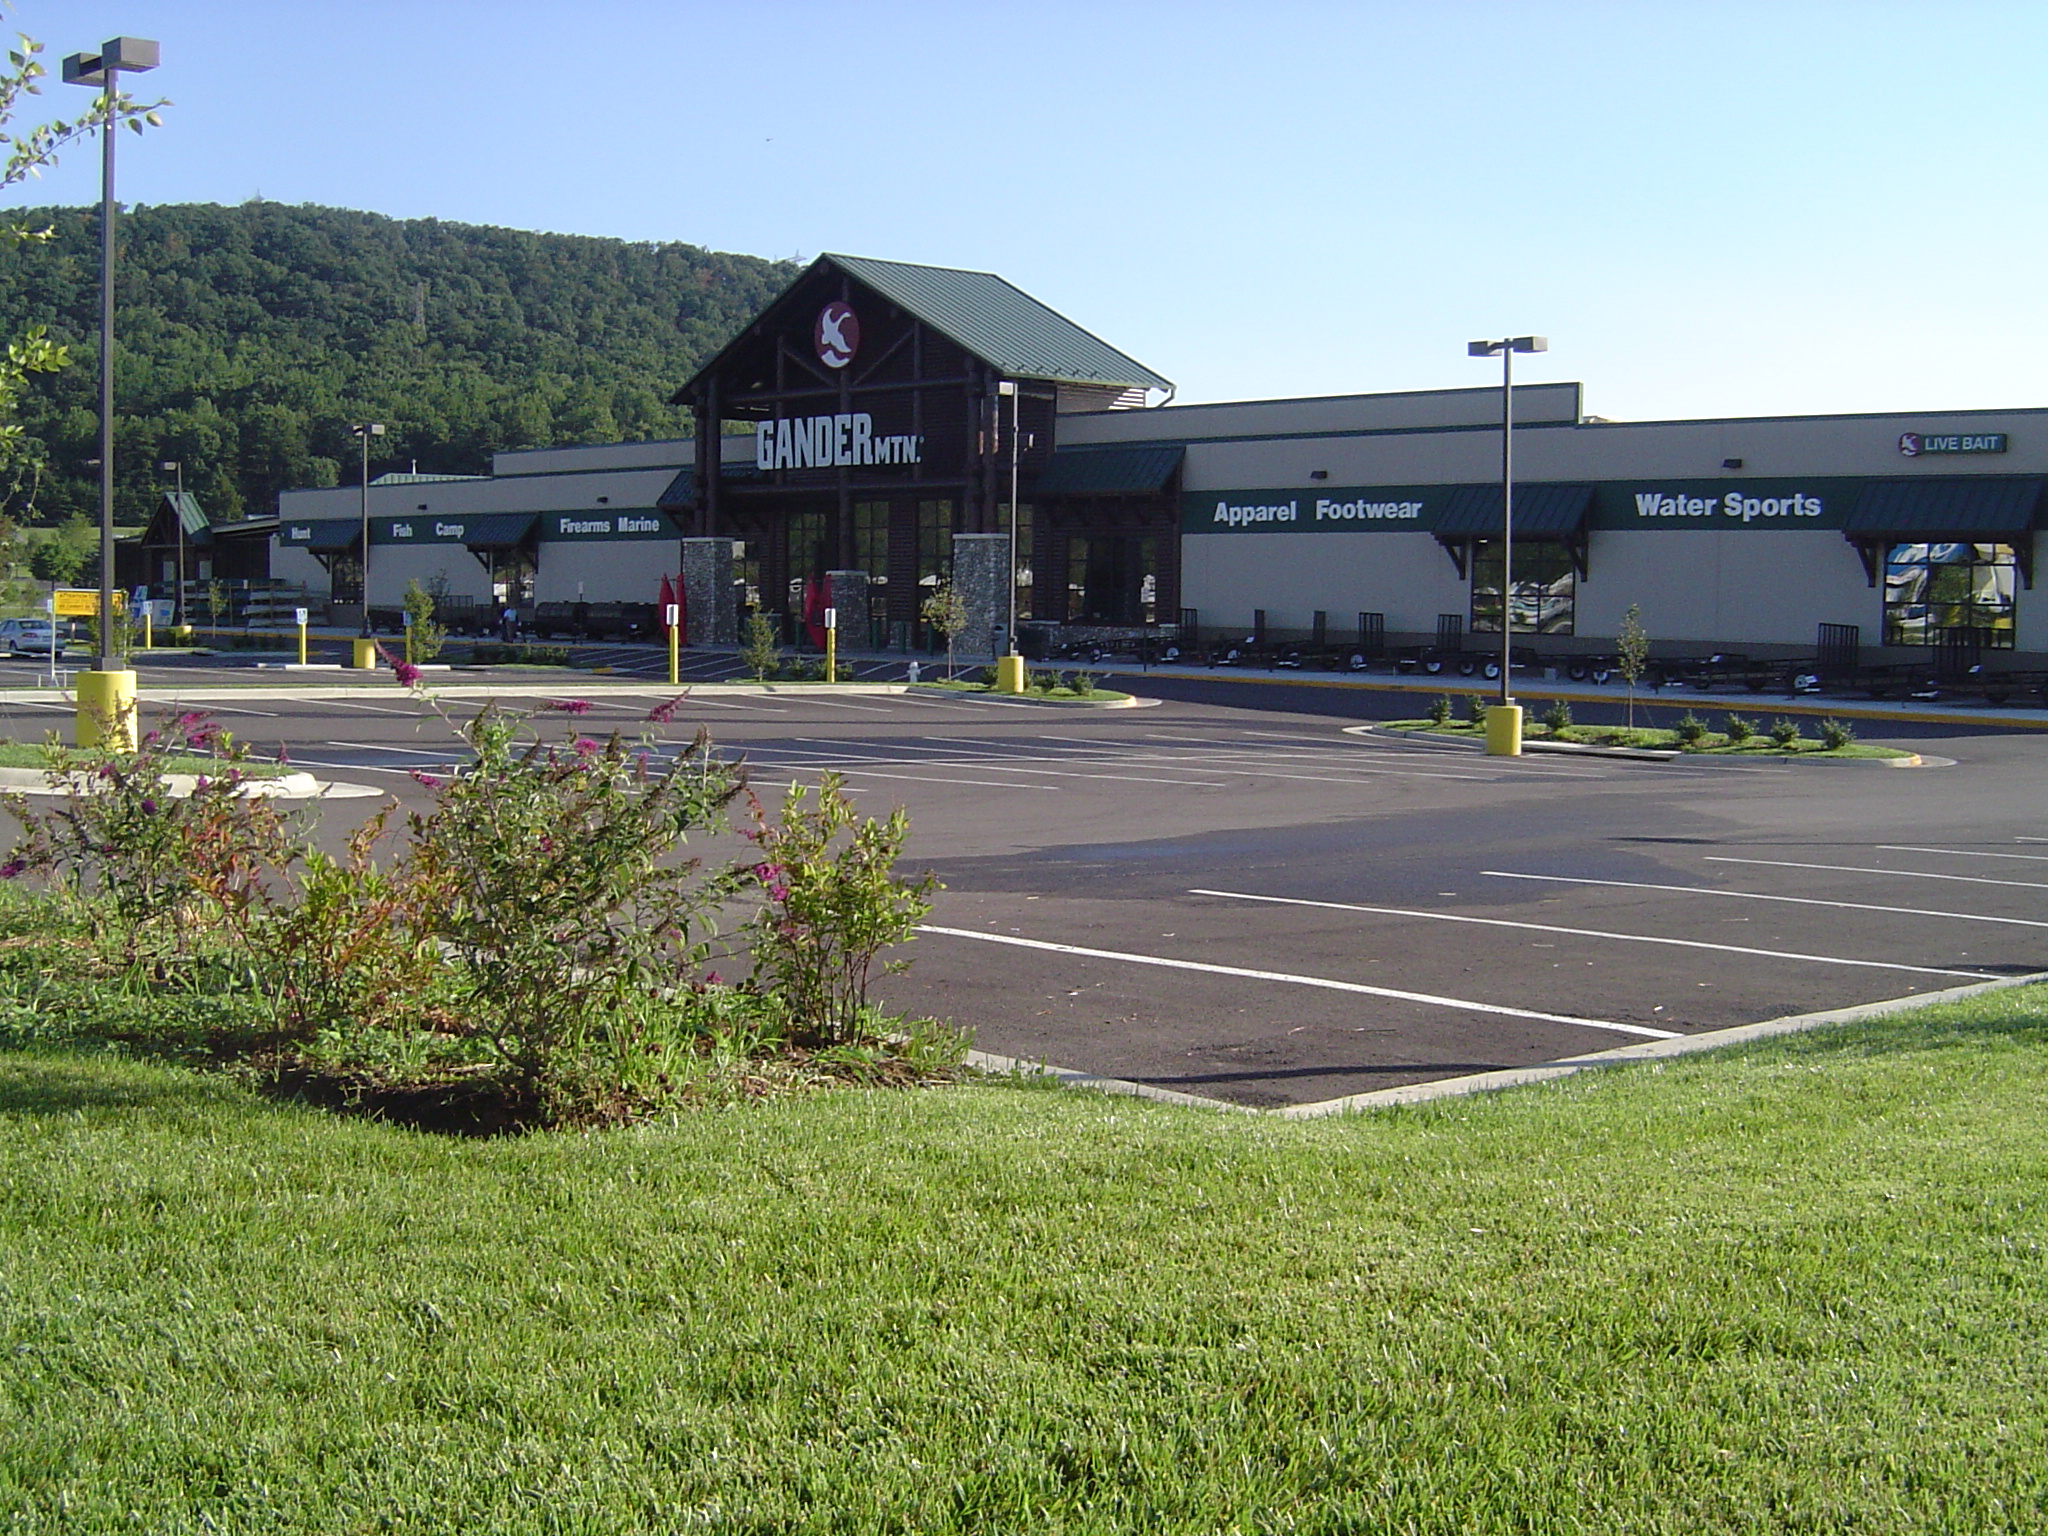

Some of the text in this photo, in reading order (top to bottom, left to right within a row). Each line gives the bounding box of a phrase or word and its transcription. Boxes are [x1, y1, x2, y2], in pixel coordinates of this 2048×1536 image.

[757, 412, 873, 470] GANDER
[1925, 436, 1998, 451] LIVE BAIT
[1213, 501, 1297, 526] Apparel
[1316, 499, 1422, 520] Footwear
[1635, 492, 1822, 522] Water Sports
[393, 523, 413, 537] Fish
[435, 522, 465, 539] Camp
[560, 518, 610, 533] Firearms
[618, 516, 660, 532] Marine
[291, 527, 311, 540] Hunt
